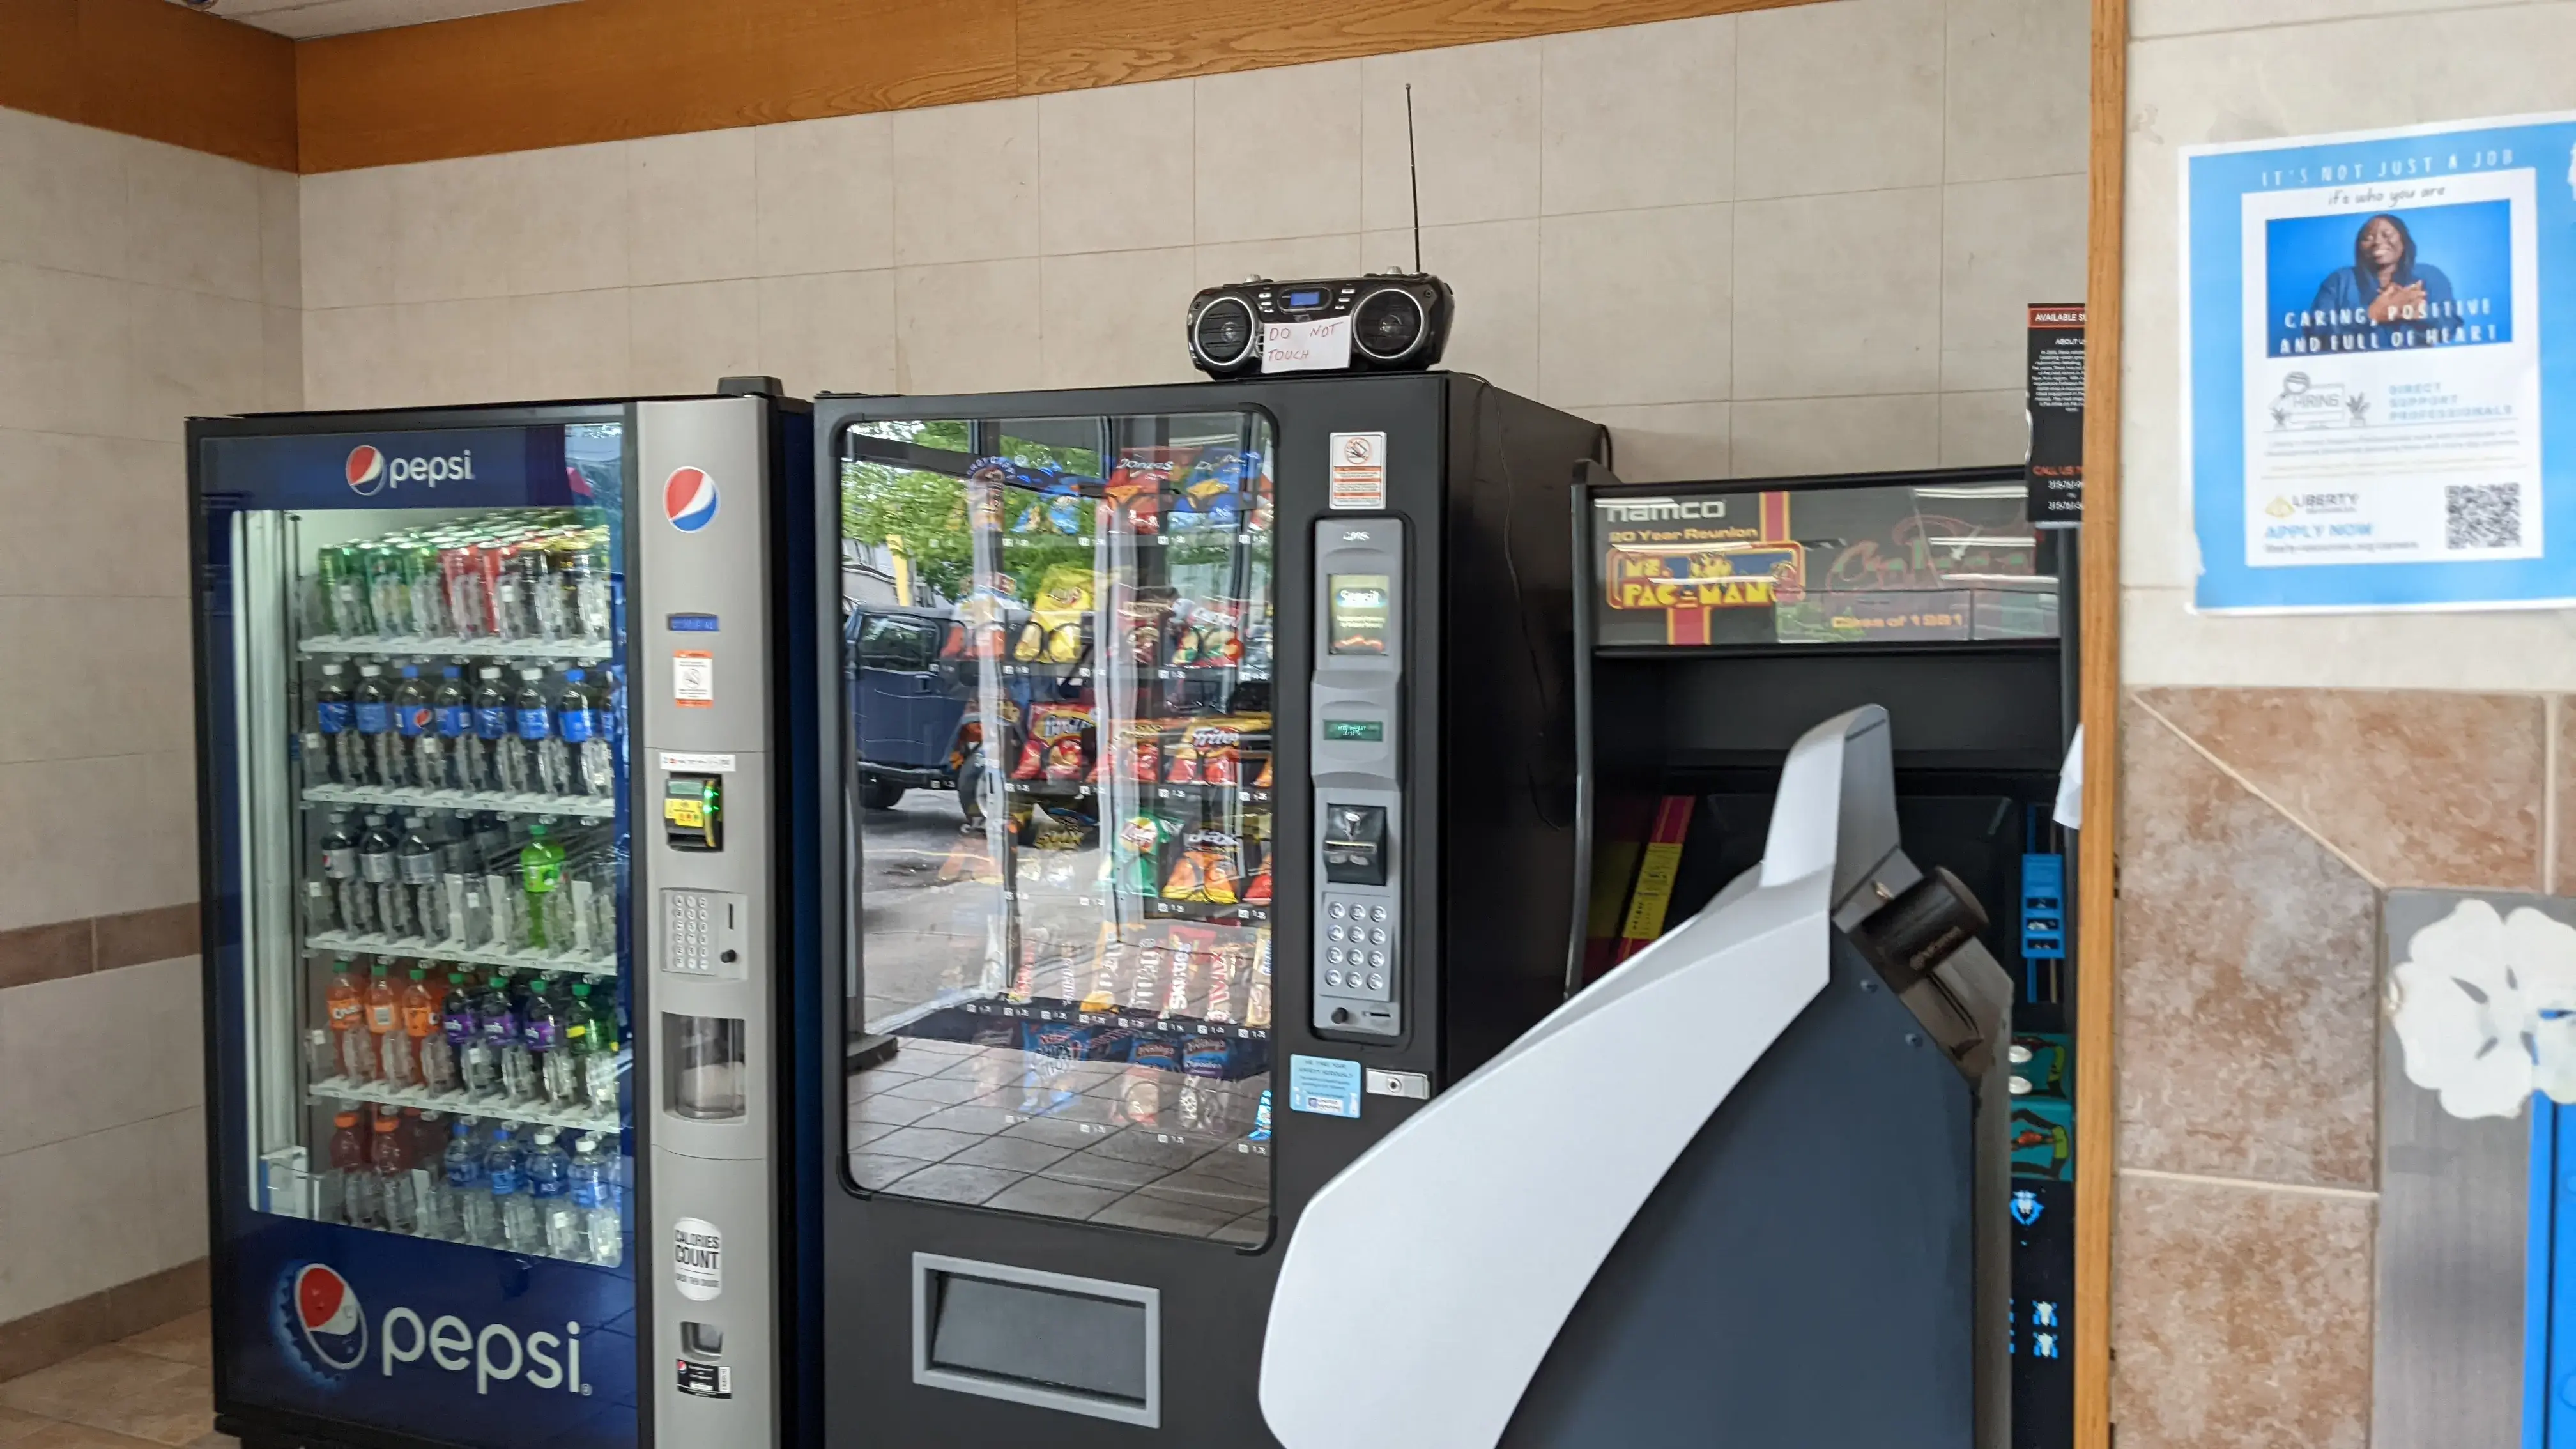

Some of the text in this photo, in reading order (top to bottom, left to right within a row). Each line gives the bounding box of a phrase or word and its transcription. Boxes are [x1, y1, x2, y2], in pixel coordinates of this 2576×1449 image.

[2262, 149, 2513, 187] IT'S NOT JUST A JOB
[2355, 187, 2384, 203] who
[2389, 188, 2416, 207] you
[2421, 186, 2446, 198] are
[2035, 313, 2076, 321] AVAILABLE
[2283, 298, 2491, 328] CARING, POSITIVE
[1269, 321, 1345, 341] DO NOT
[2280, 324, 2497, 355] AND FULL OF HEART
[1267, 349, 1310, 362] TOUCH
[2292, 393, 2340, 408] HIRING
[2388, 394, 2458, 408] SUPPORT
[2388, 404, 2513, 421] PROFESSIONALS
[389, 449, 473, 489] pepsi
[2292, 493, 2359, 507] LIBERTY
[1607, 500, 1724, 523] namco
[1638, 529, 1682, 542] Year
[1684, 527, 1759, 540] Reunion
[2265, 523, 2373, 539] APPLY NOW
[1622, 581, 1777, 607] PAC-MAN
[1831, 613, 1963, 629] Class of 1981
[381, 1306, 581, 1395] pepsi
